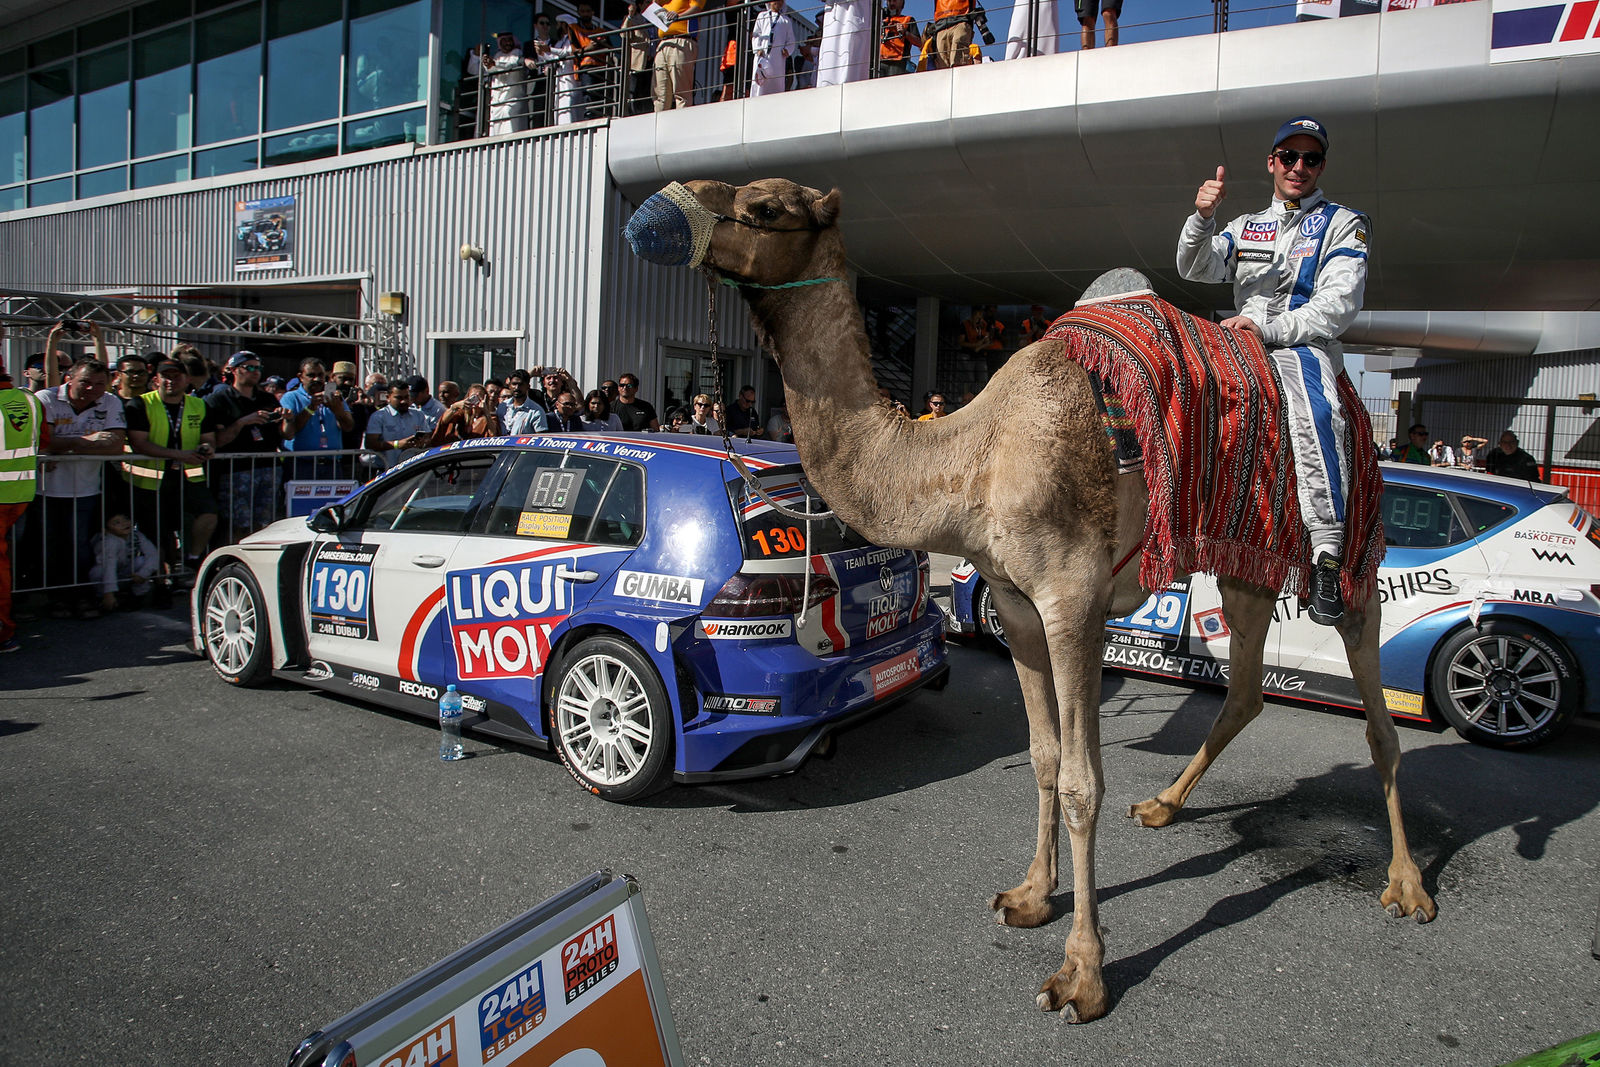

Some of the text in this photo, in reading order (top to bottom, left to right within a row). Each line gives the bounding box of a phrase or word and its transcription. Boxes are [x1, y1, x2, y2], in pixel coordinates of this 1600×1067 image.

[1246, 221, 1277, 232] LIQUI
[1242, 231, 1275, 241] MOLY
[450, 435, 510, 450] B. Leuchter
[526, 437, 577, 449] F. Thoma
[614, 446, 657, 461] Vernay
[539, 515, 570, 524] POSITION
[542, 523, 569, 532] Systems
[752, 526, 806, 556] 130
[1514, 530, 1577, 546] BASKOETEN
[844, 558, 866, 570] TEAM
[315, 567, 366, 612] 130
[452, 563, 568, 620] LIQUI
[622, 573, 692, 603] GUMBA
[871, 593, 900, 618] LIQUI
[1513, 589, 1558, 606] MBA
[1114, 593, 1182, 629] 29
[318, 623, 360, 637] 24H DUBAI
[868, 612, 899, 637] MOLY
[1112, 634, 1166, 649] 24H DUBAI
[358, 674, 380, 688] PAGID
[399, 681, 439, 700] RECARO
[1390, 698, 1421, 709] Systems
[564, 919, 614, 972] 24H
[566, 945, 614, 988] PROTO
[569, 960, 616, 1000] SERIES
[482, 967, 540, 1028] 24H
[484, 992, 542, 1040] TCE
[486, 1012, 543, 1059] SERIES
